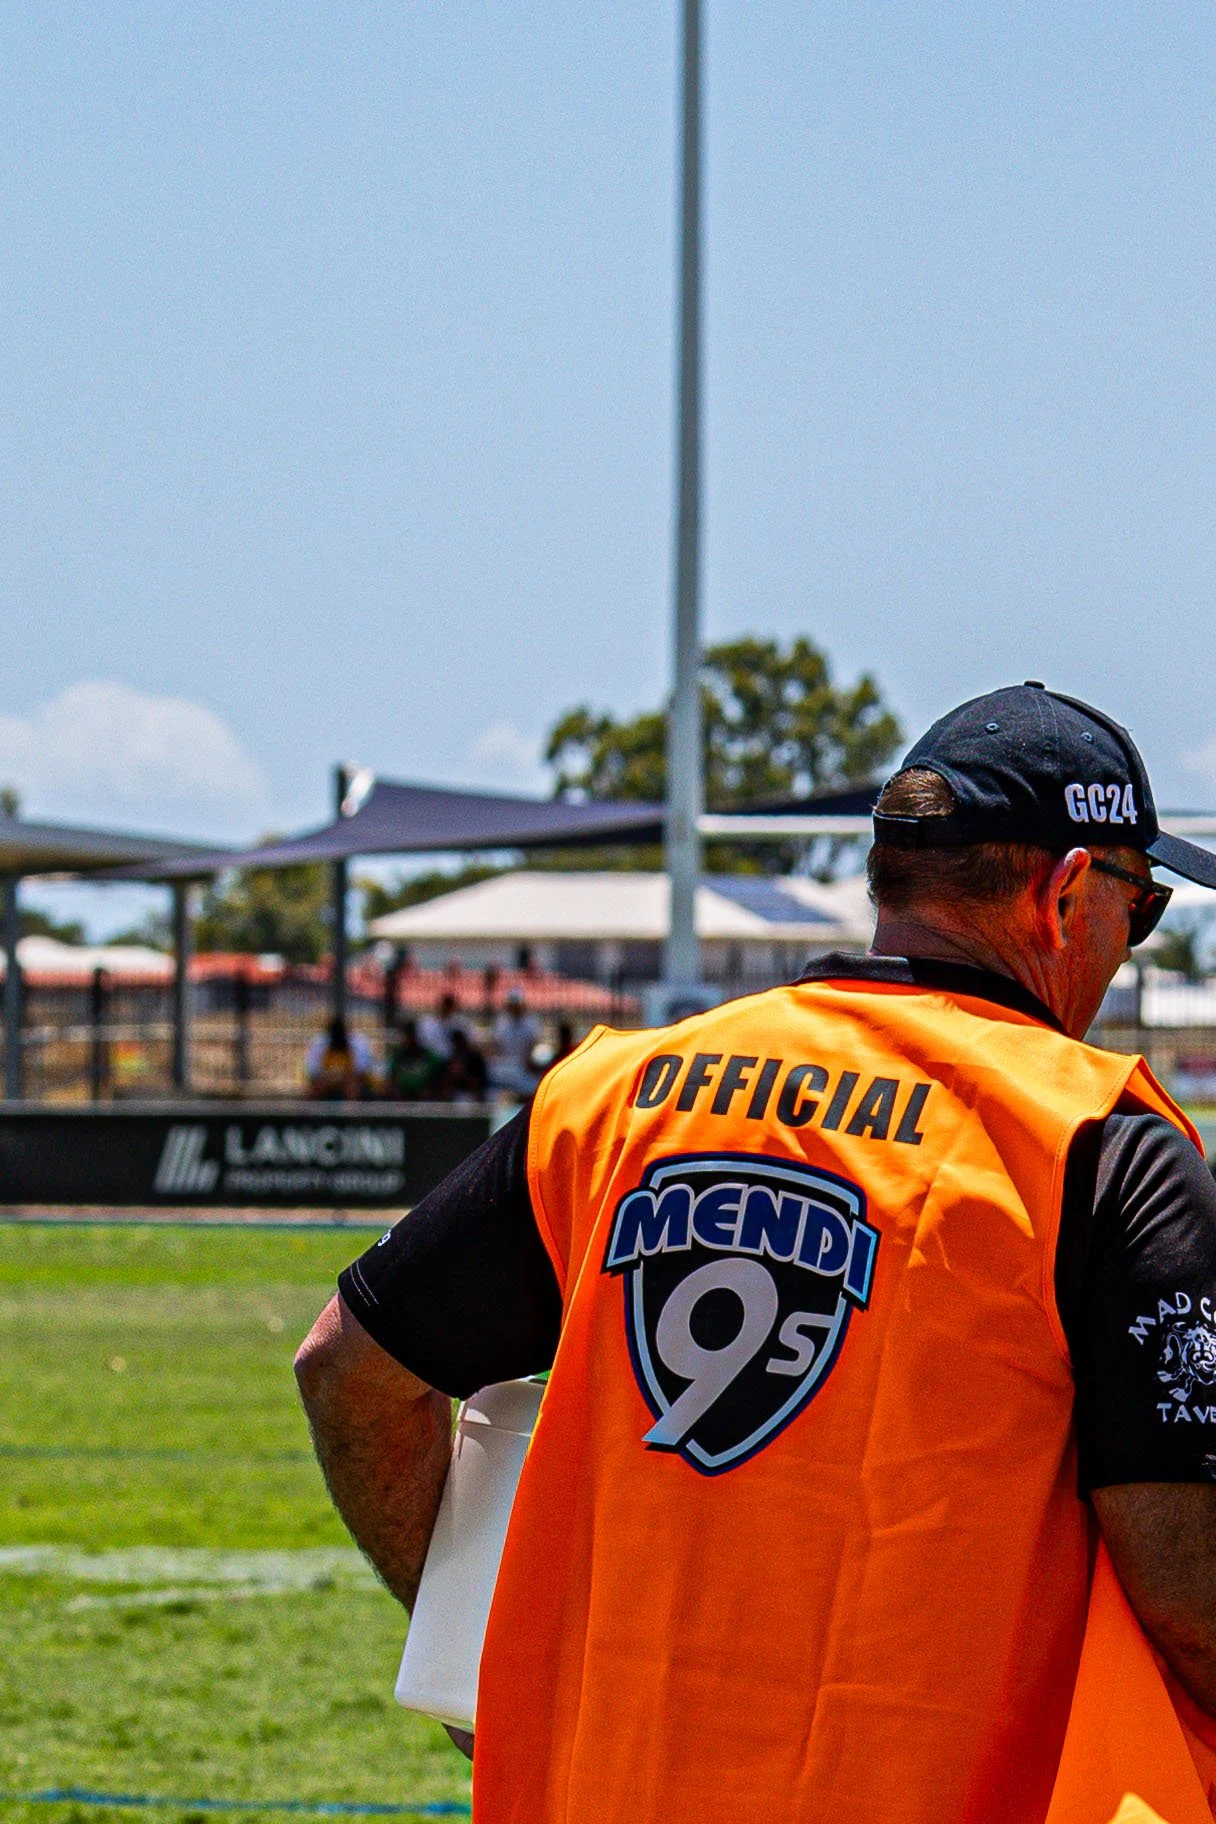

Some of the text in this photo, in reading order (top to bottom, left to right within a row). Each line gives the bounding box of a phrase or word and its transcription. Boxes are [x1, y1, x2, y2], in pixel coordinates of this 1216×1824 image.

[1064, 783, 1138, 825] GC24
[635, 1052, 931, 1146] OFFICIAL
[223, 1125, 405, 1166] LANCINI
[604, 1181, 879, 1304] MENDI
[1128, 1292, 1192, 1346] MAD
